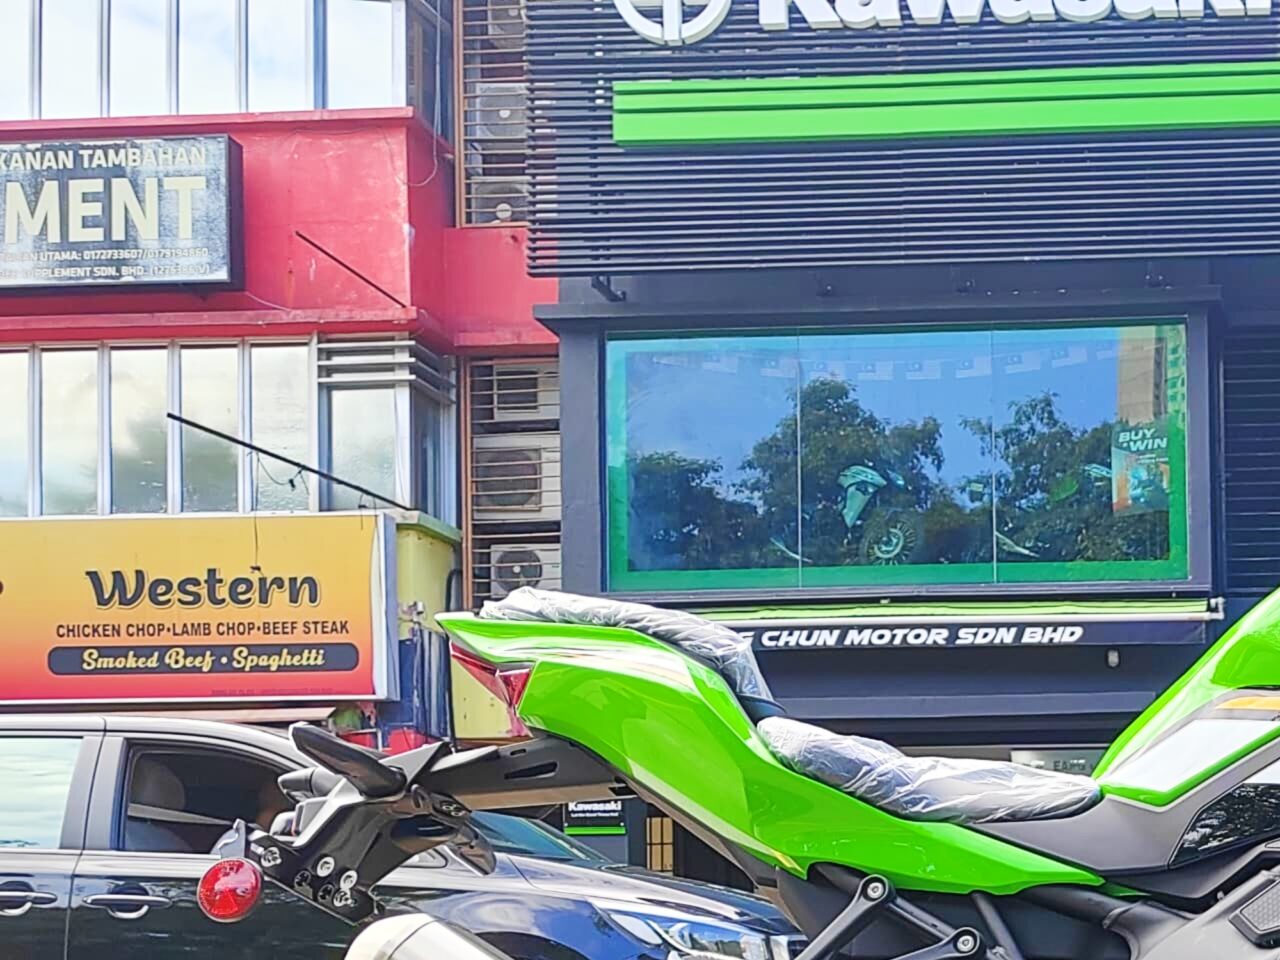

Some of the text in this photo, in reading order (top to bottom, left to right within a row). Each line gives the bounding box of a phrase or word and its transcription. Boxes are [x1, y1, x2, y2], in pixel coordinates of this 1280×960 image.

[78, 147, 206, 169] TAMBAHAN
[4, 176, 206, 244] MENT
[40, 249, 81, 261] UTAMA:
[93, 266, 120, 278] SDN.
[1118, 428, 1156, 443] BUY
[85, 566, 320, 608] Western
[56, 623, 121, 639] CHICKEN
[302, 619, 350, 635] STEAK
[761, 629, 840, 647] CHUN
[843, 627, 948, 646] MOTOR
[954, 627, 1014, 645] SDN
[1020, 626, 1084, 644] BHD
[81, 646, 326, 673] Smoked Beef Spaghetti
[568, 801, 621, 811] Kawasaki
